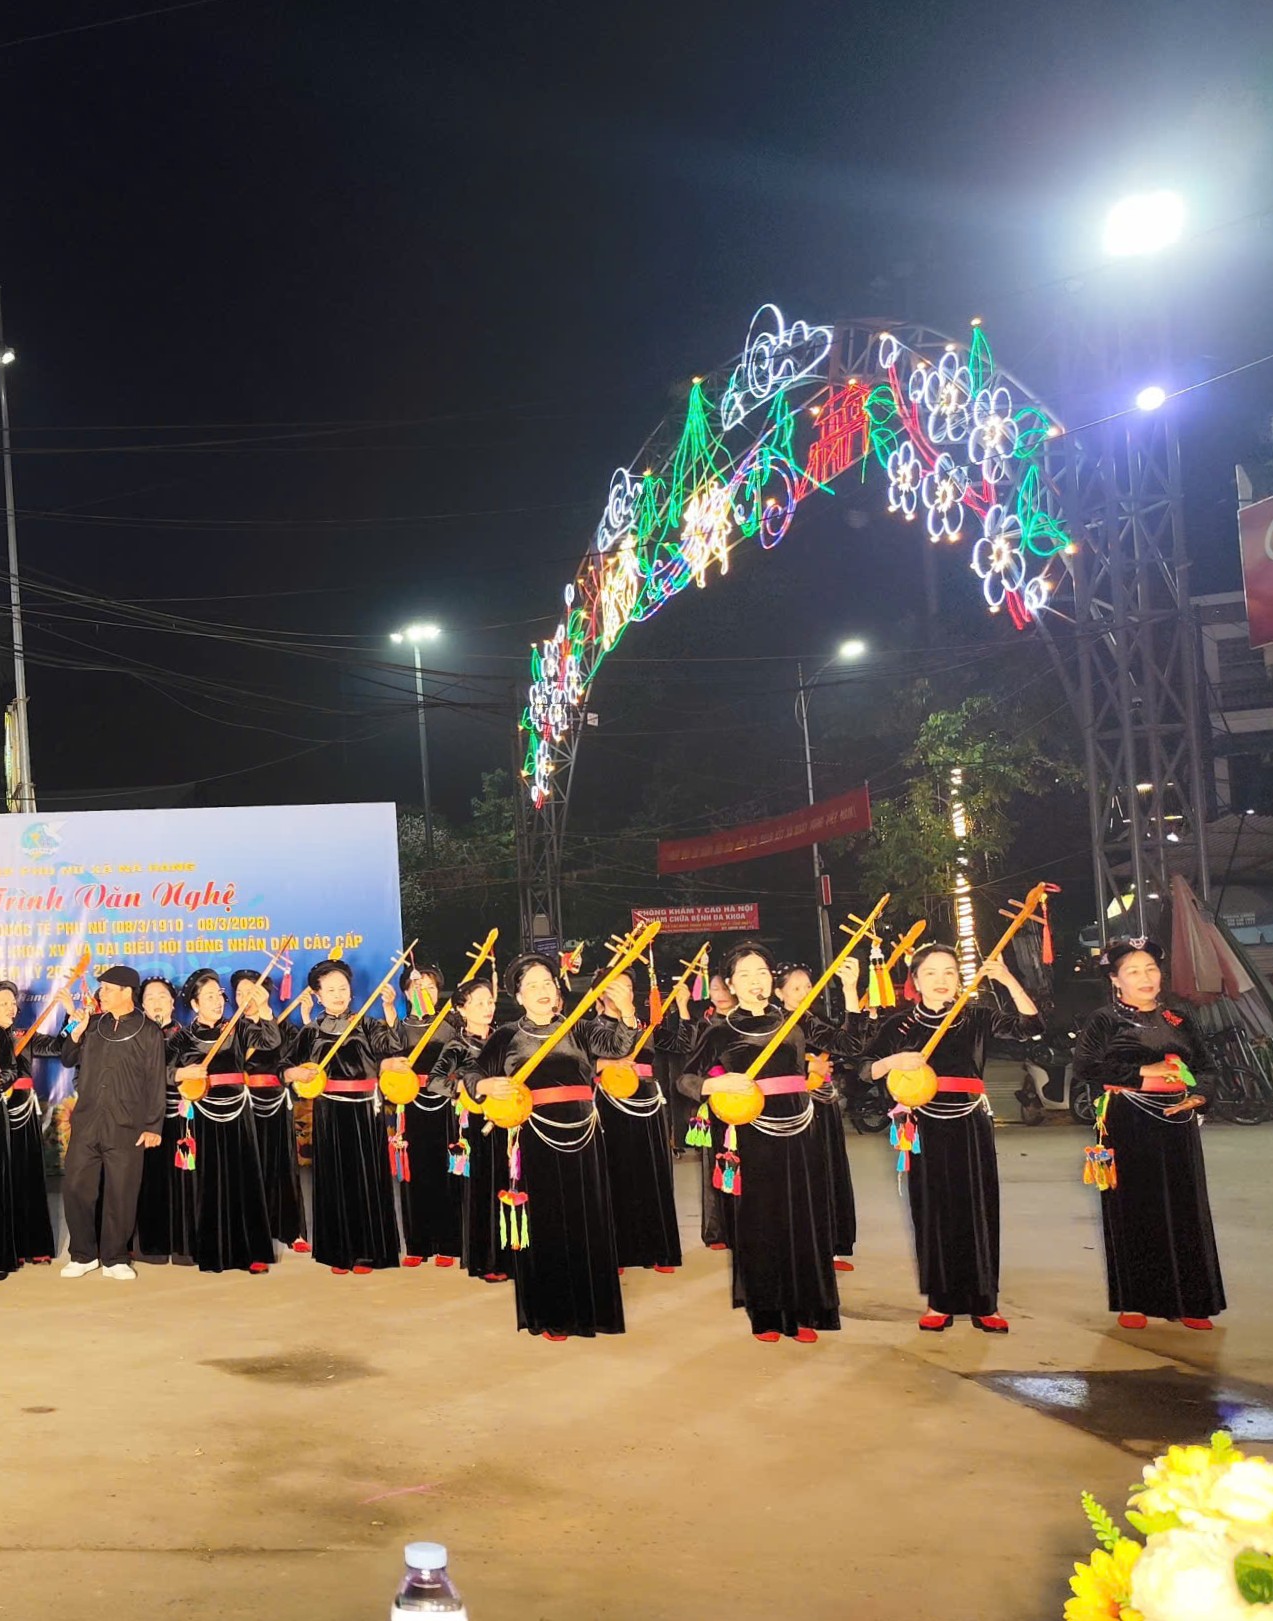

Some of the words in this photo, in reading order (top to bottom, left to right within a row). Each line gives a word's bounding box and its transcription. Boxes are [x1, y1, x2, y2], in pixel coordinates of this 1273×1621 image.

[74, 884, 141, 910] Văn
[152, 880, 237, 914] Nghệ
[669, 905, 695, 915] KHÁM
[704, 905, 722, 914] CAO
[724, 904, 737, 913] HÀ
[738, 902, 755, 913] NỘI
[691, 912, 712, 923] BỆNH
[726, 911, 747, 921] KHOA
[88, 917, 108, 935] NỮ
[111, 917, 184, 935] (08/3/1910
[197, 915, 271, 932] 08/3/2026)
[123, 936, 155, 955] BIỂU
[158, 936, 180, 957] HỘI
[186, 934, 224, 954] ĐỒNG
[227, 934, 267, 952] NHÂN
[271, 932, 299, 950] DÂN
[303, 930, 331, 950] CÁC
[334, 929, 364, 950] CẤP
